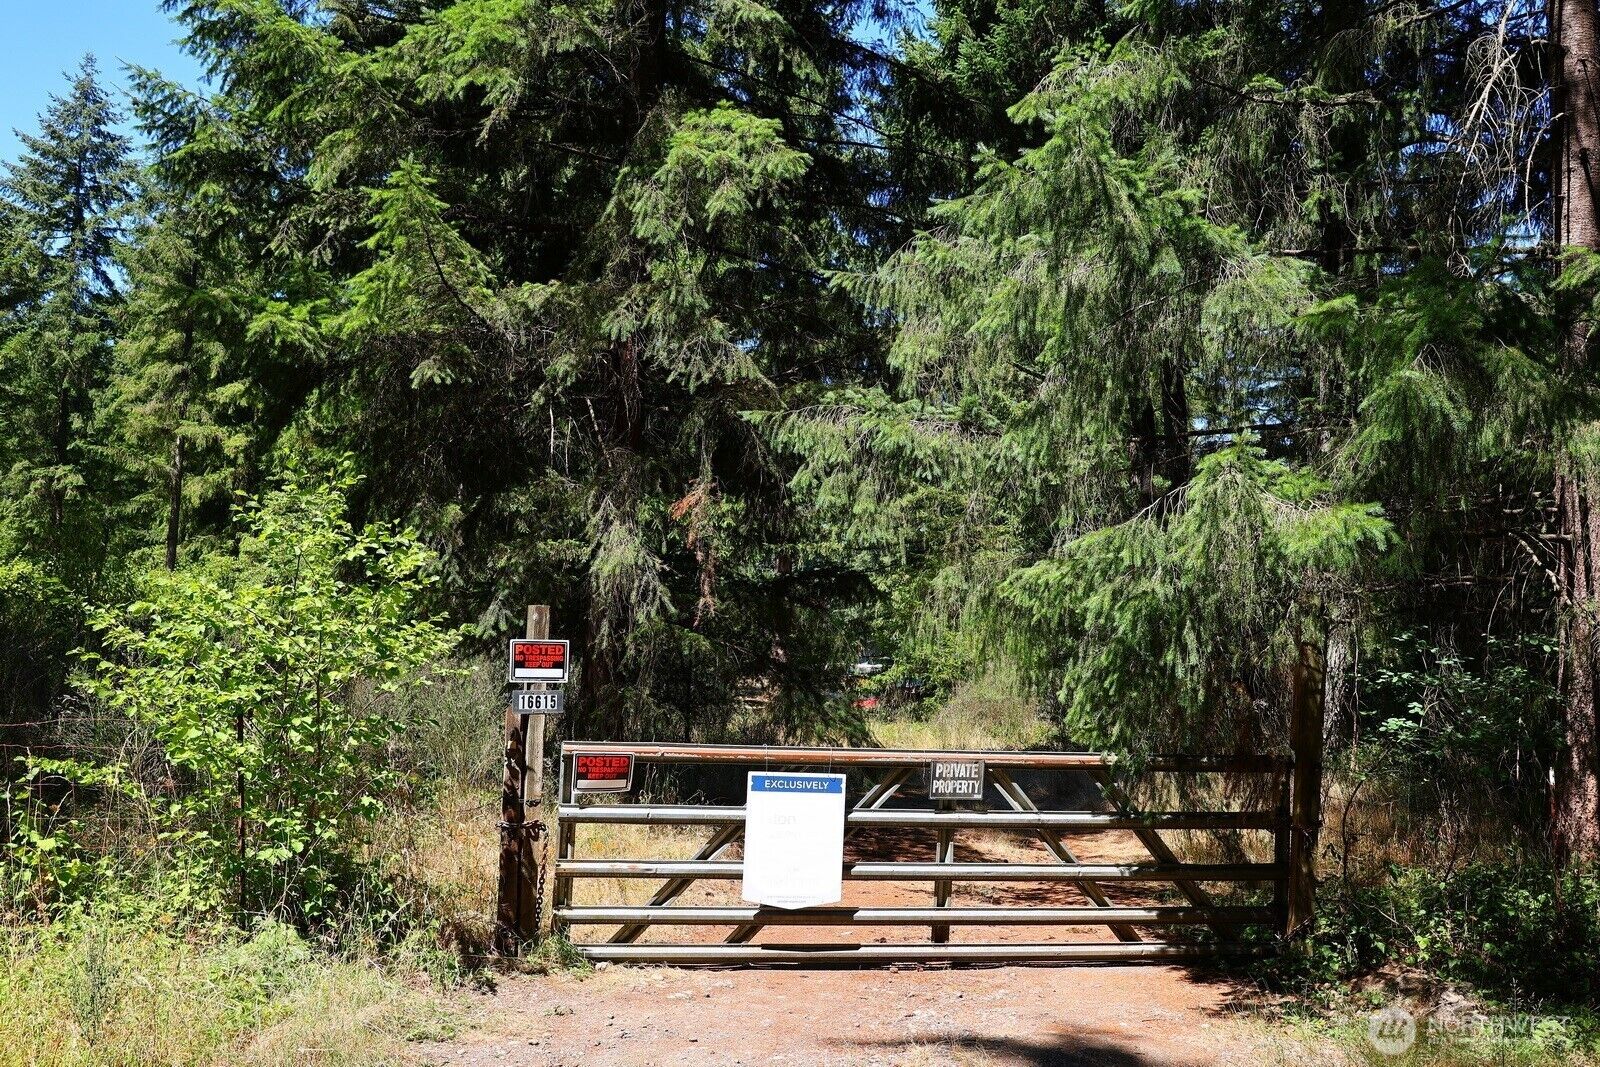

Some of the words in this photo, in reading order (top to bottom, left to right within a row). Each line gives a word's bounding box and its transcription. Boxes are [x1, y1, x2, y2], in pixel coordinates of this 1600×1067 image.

[515, 644, 564, 654] POSTED
[521, 695, 556, 709] 16615
[578, 756, 629, 767] POSTED
[935, 763, 979, 778] PRIVATE
[764, 779, 829, 790] EXCLUSIVELY
[932, 779, 980, 793] PROPERTY
